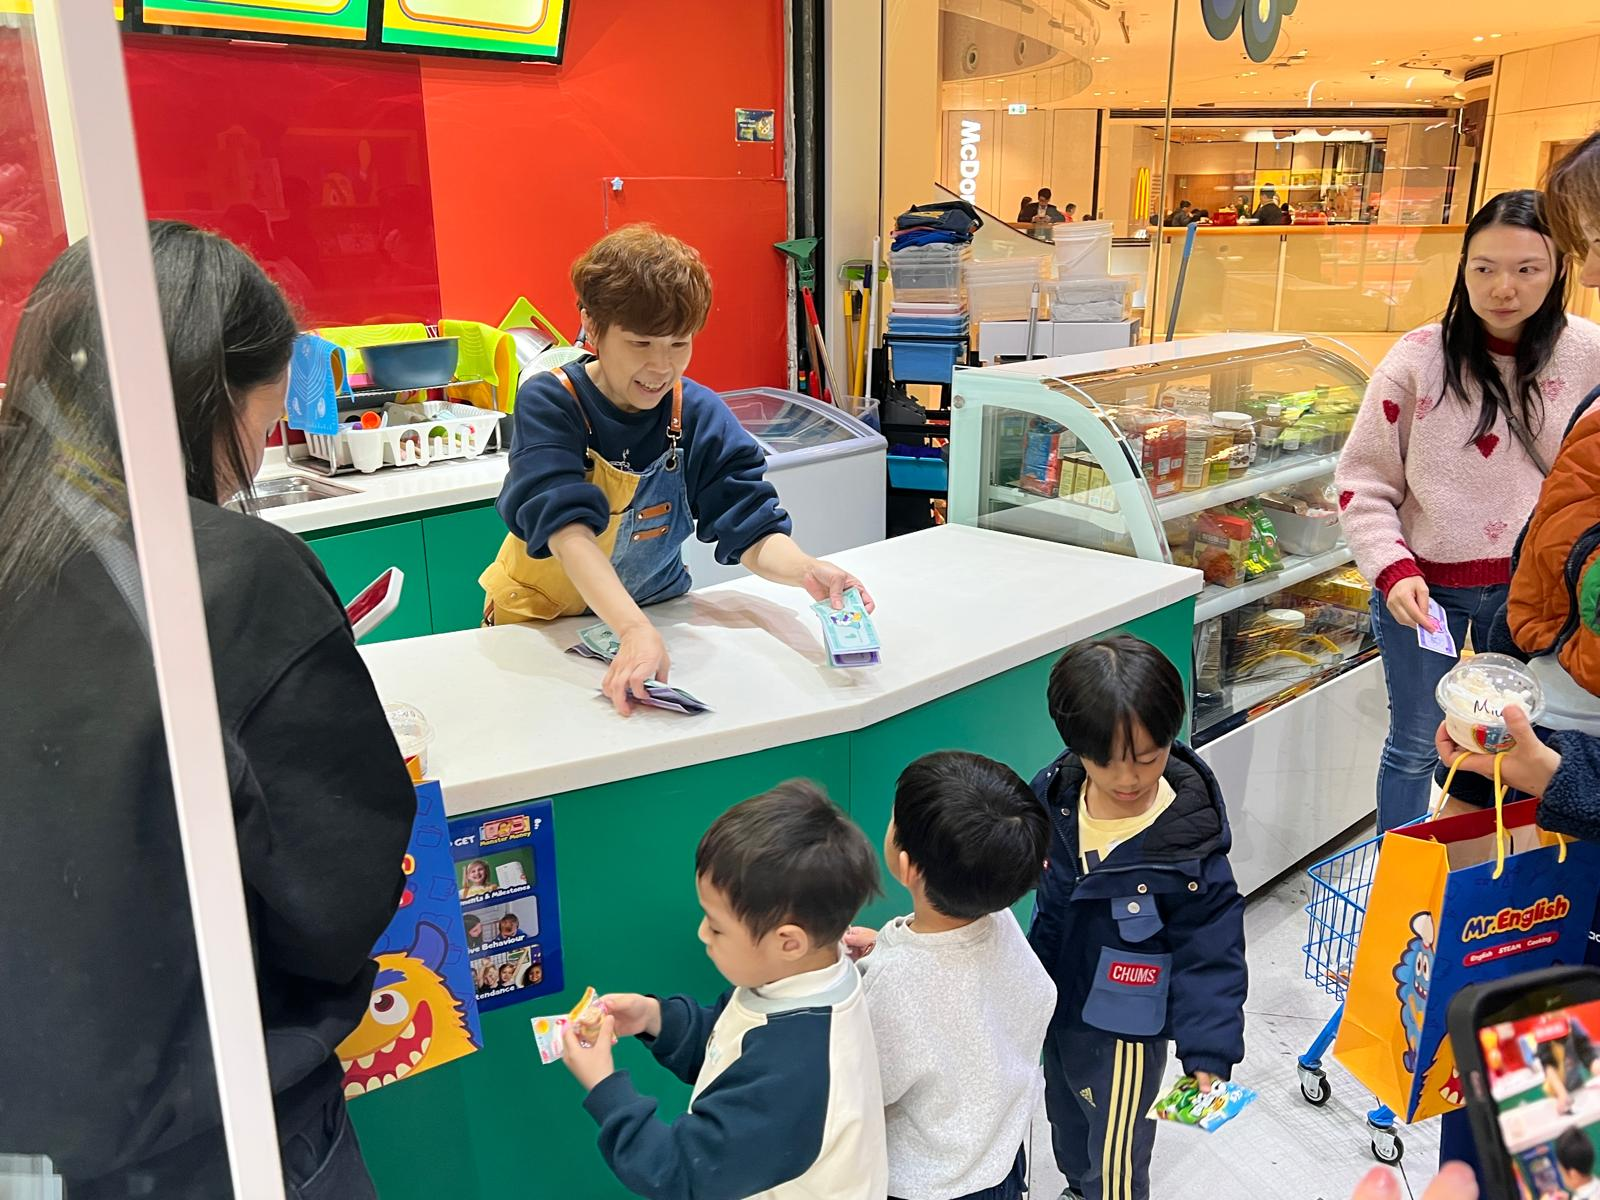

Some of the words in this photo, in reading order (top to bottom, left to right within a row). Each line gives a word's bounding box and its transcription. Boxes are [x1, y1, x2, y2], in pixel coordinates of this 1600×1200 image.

[454, 835, 475, 846] GET
[480, 836, 508, 846] Monster
[491, 885, 531, 898] Milestones
[1462, 895, 1570, 942] Mr.English
[482, 935, 525, 951] Behaviour
[1470, 951, 1493, 962] English
[1498, 943, 1522, 954] STEAM
[1527, 936, 1552, 947] Cooking
